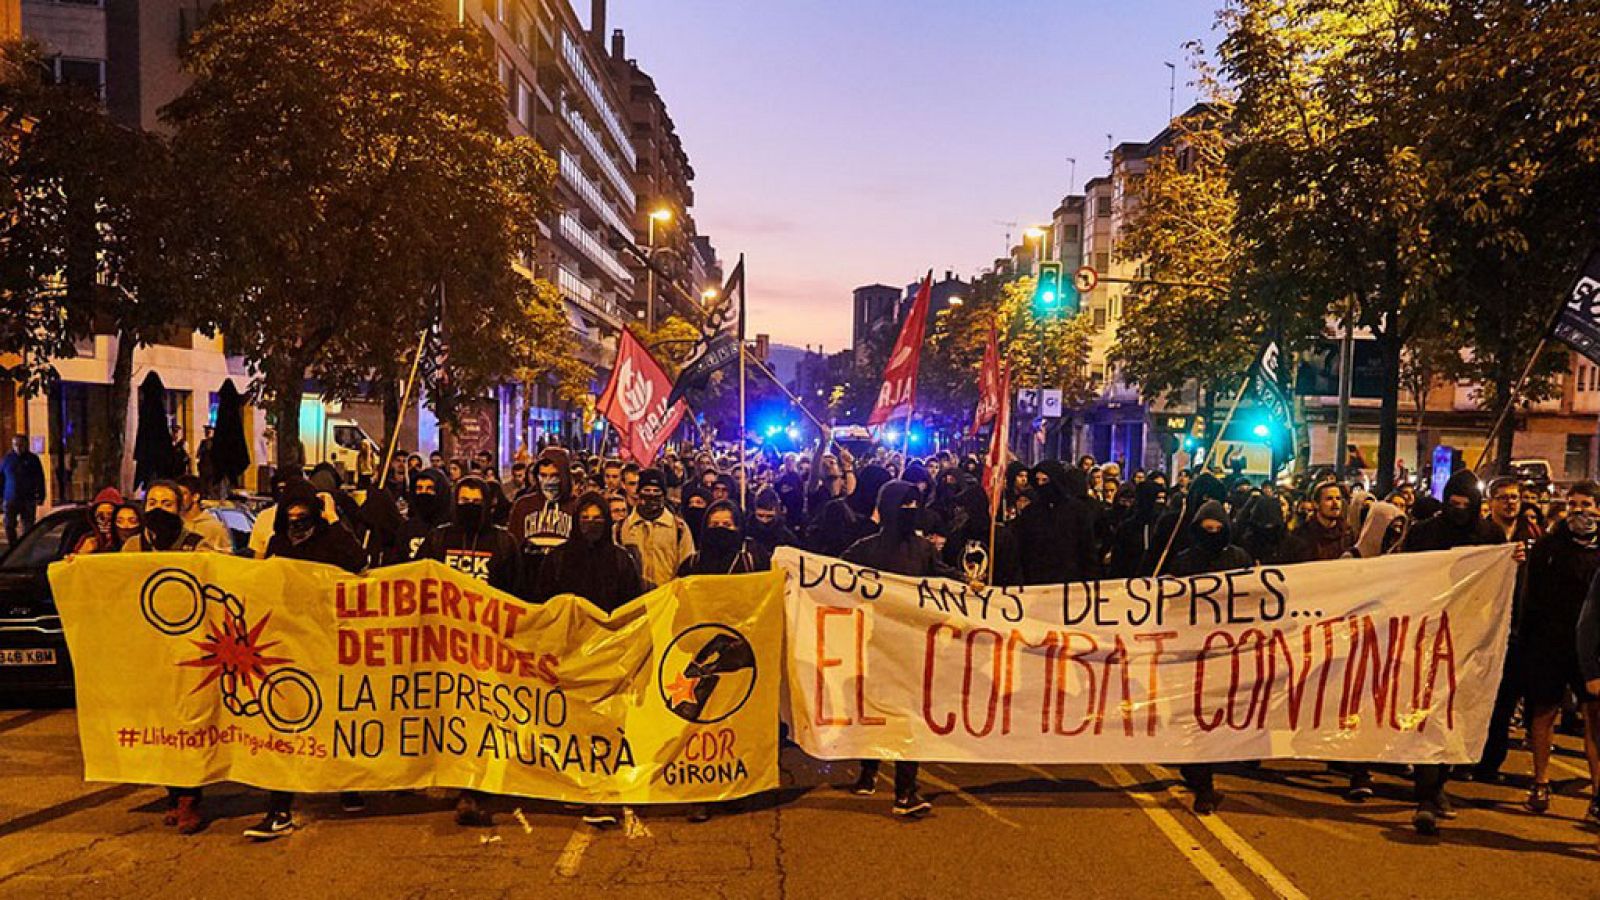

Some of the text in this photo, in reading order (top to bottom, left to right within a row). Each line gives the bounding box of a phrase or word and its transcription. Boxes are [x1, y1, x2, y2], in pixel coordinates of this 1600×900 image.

[335, 578, 526, 638] LLIBERTAT
[799, 555, 883, 600] DOS
[917, 578, 1024, 622] ANYS
[338, 625, 560, 685] DETINGUDES
[815, 606, 1457, 737] EL COMBAT CONTINUA
[338, 671, 567, 728] LA REPRESSIÓ
[333, 715, 636, 776] NO ENS ATURARÀ
[685, 727, 737, 762] CDR
